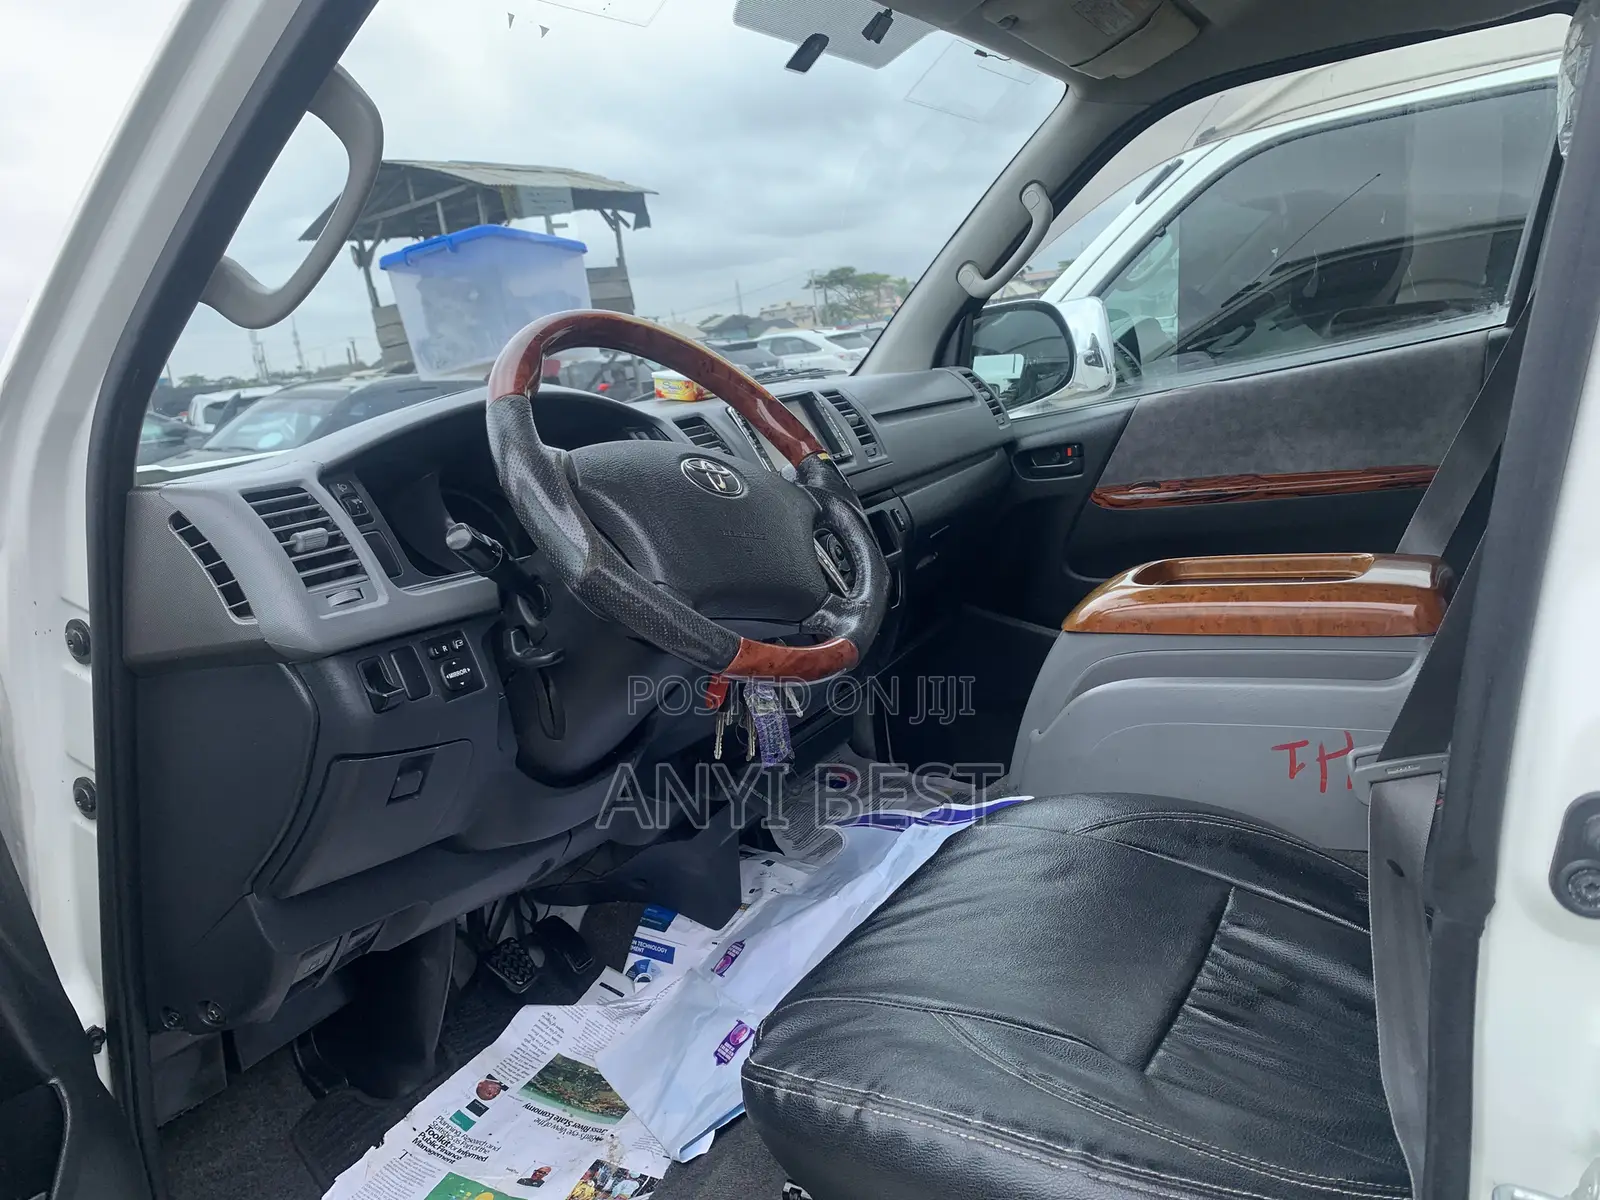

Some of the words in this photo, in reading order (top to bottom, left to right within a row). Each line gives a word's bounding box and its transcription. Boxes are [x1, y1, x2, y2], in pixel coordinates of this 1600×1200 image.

[449, 668, 468, 679] MIRROR
[637, 941, 668, 954] TECHNOLOGY
[522, 1102, 554, 1121] Economy
[553, 1114, 574, 1127] State
[430, 1120, 454, 1141] Statistics
[571, 1122, 592, 1133] River
[411, 1137, 456, 1165] Management
[418, 1131, 439, 1150] Public
[436, 1145, 462, 1161] Finance
[424, 1125, 451, 1147] Toolkit
[457, 1146, 490, 1163] Informed
